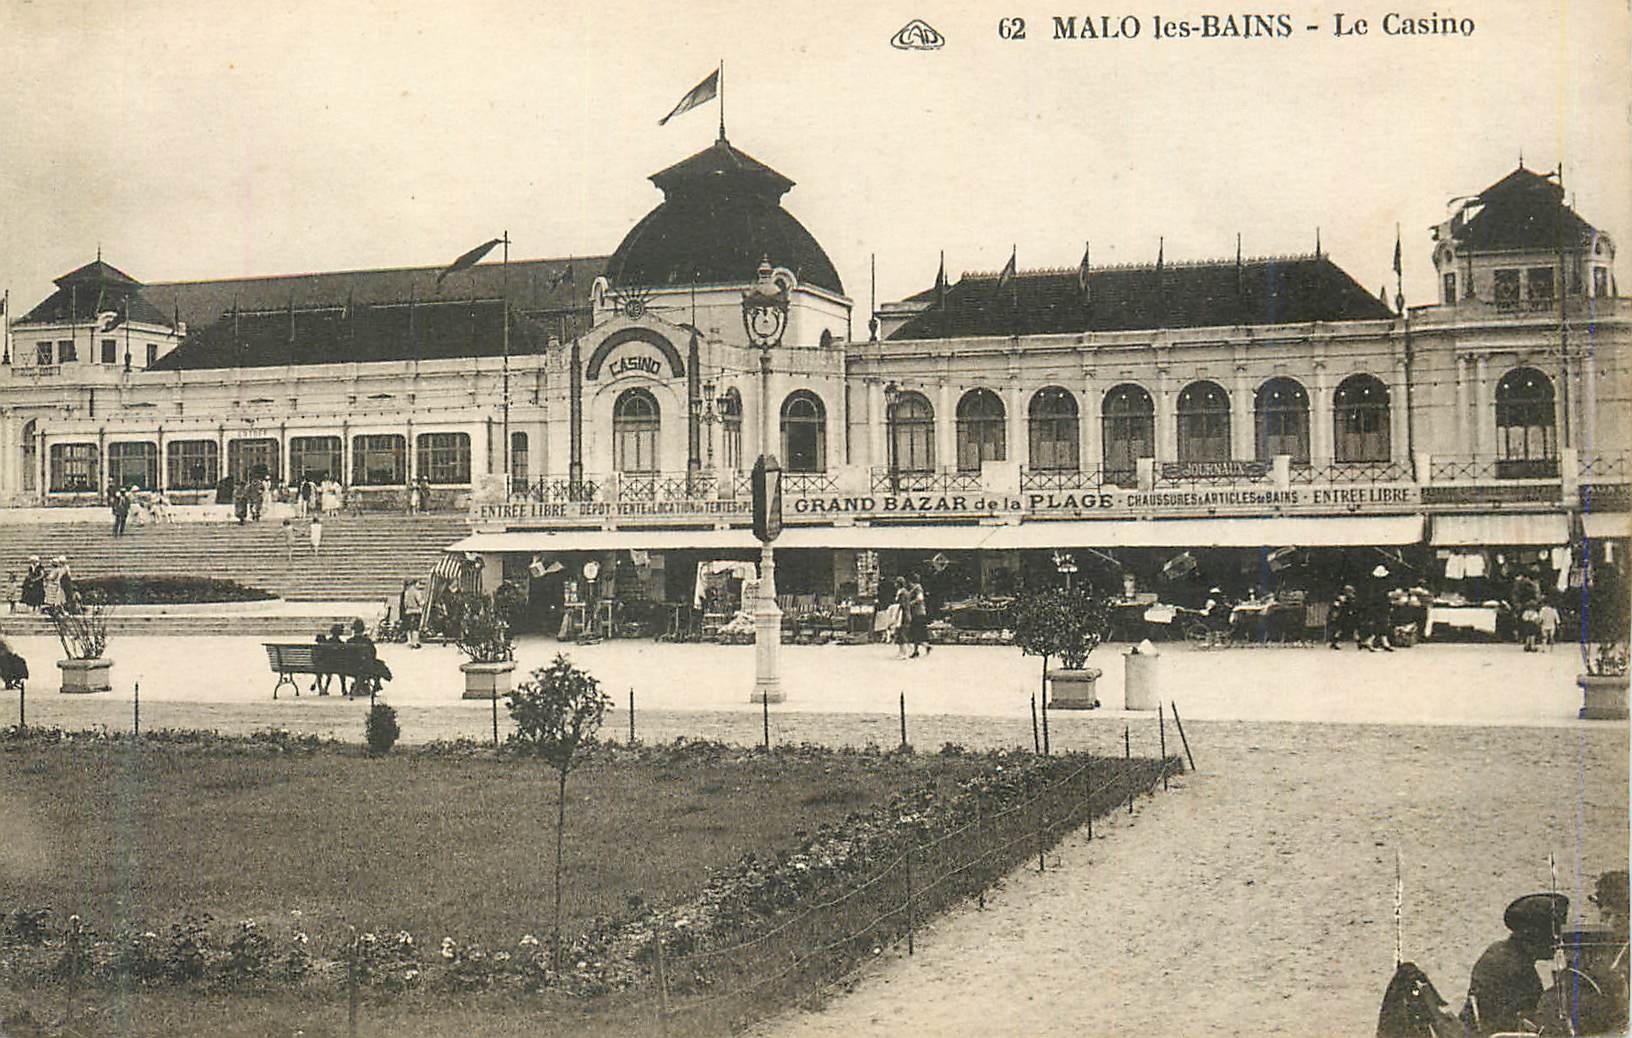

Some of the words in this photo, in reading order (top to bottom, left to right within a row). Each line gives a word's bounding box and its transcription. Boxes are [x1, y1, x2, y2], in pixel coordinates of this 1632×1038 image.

[608, 356, 662, 377] CASINO
[794, 497, 876, 513] GRAND
[882, 496, 967, 512] BAZAR
[974, 496, 999, 510] de
[1004, 497, 1022, 510] la
[1029, 493, 1114, 509] PLAGE
[1127, 493, 1199, 508] CHAUSSURES
[1205, 491, 1257, 505] ARTICLES
[1266, 490, 1299, 504] BAINS
[1369, 487, 1411, 502] LIBRE
[530, 503, 568, 518] LIBRE
